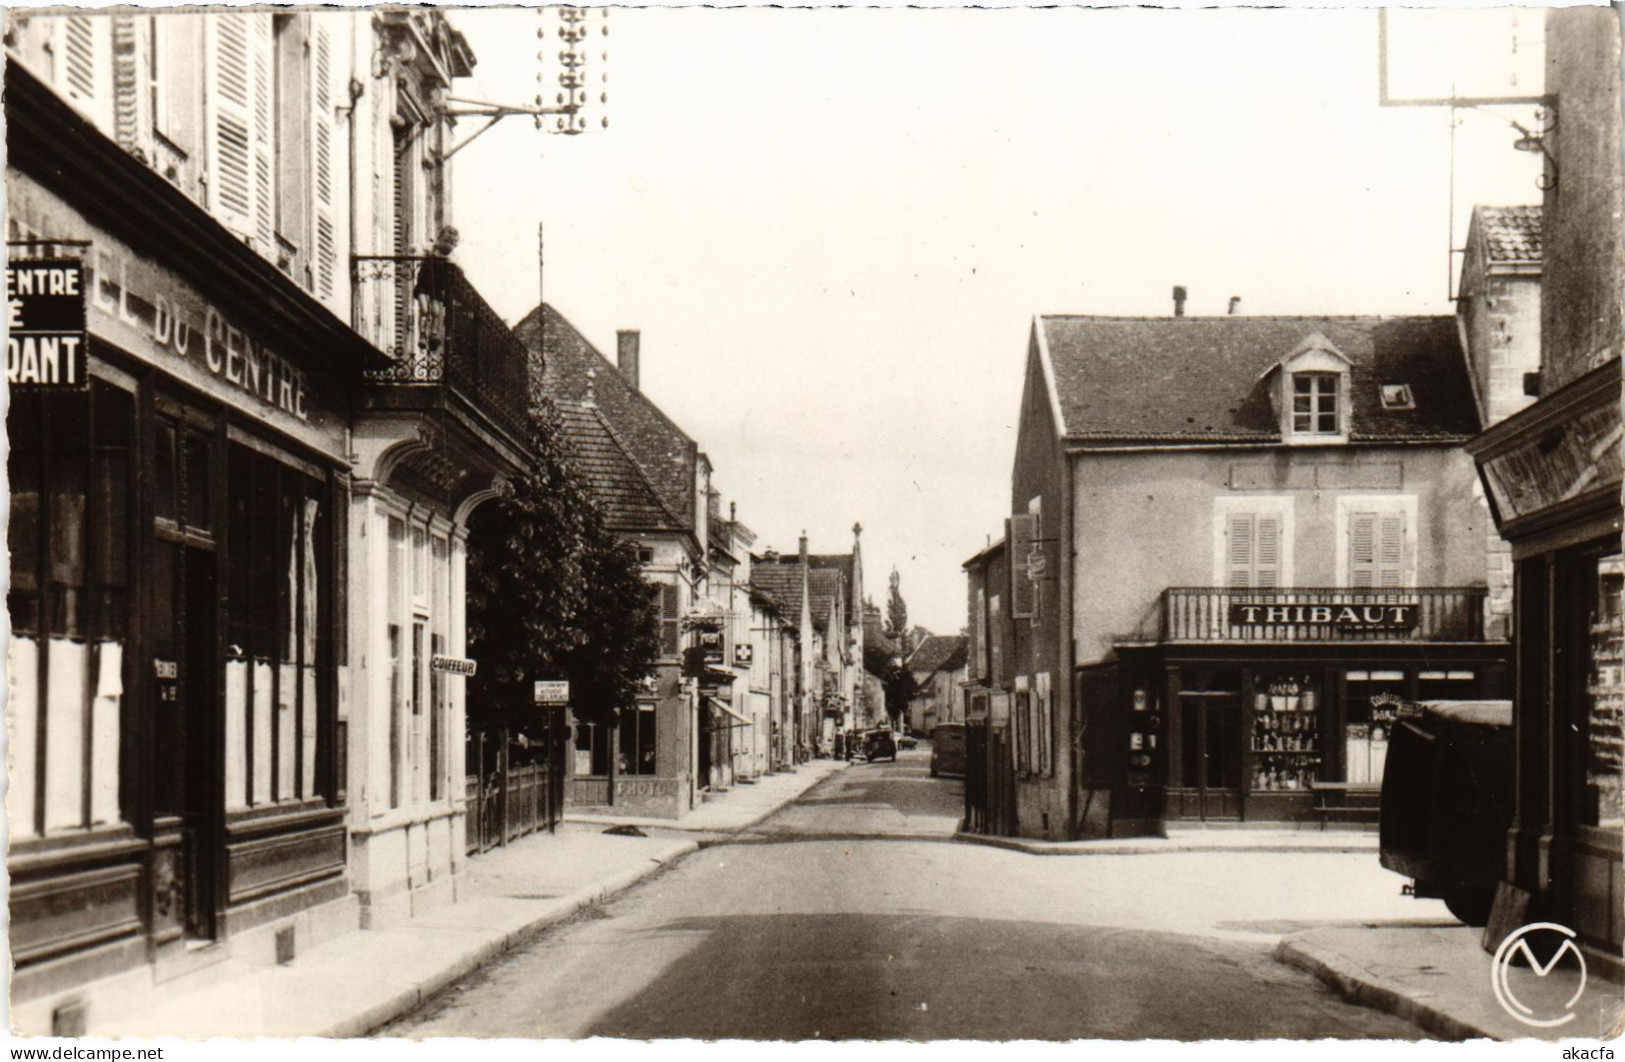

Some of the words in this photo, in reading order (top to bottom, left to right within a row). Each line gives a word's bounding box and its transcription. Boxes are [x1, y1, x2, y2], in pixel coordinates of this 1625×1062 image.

[155, 292, 189, 355] DU
[204, 304, 308, 420] CENTRE
[1241, 606, 1410, 623] THIBAUT
[433, 657, 474, 674] COIFFEUR
